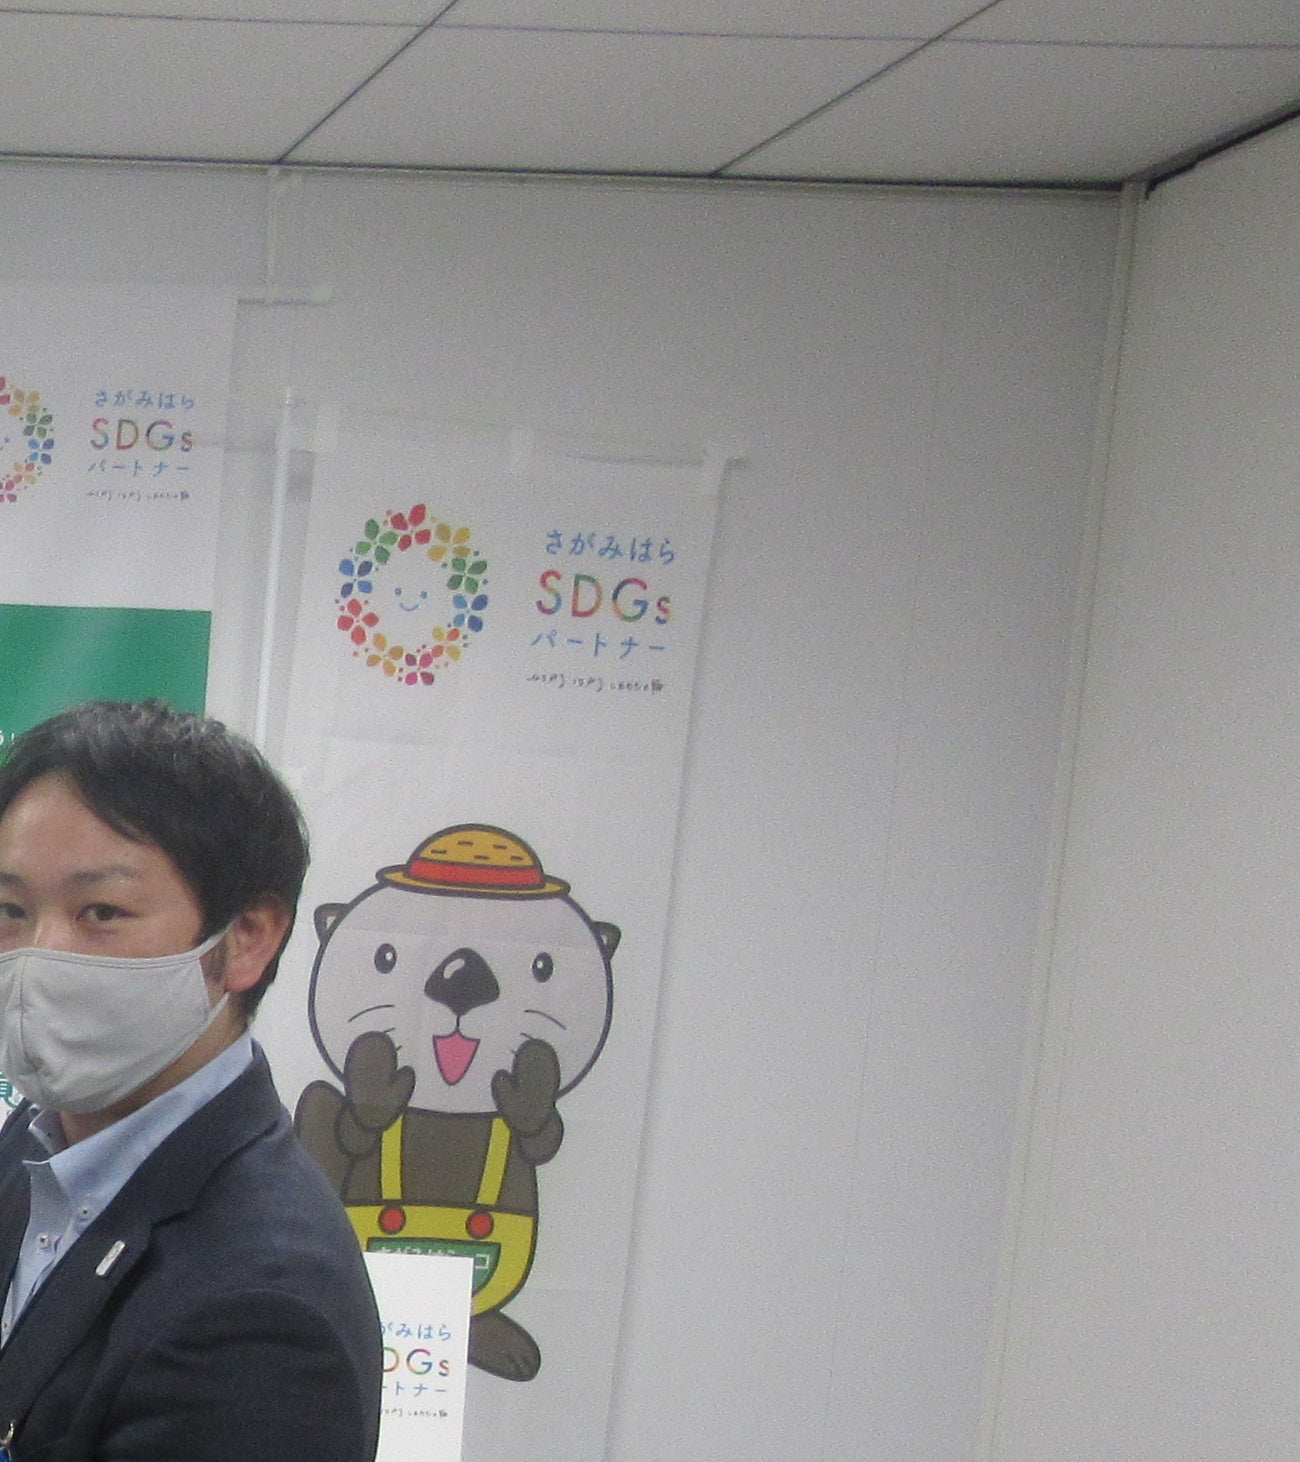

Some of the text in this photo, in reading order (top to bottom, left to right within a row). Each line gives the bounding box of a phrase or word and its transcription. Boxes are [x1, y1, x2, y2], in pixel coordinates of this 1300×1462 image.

[93, 387, 197, 412] さがみはら
[89, 415, 196, 454] SDGs
[86, 458, 192, 478] パートナー
[546, 529, 675, 565] さがみはら
[535, 569, 671, 624] SDGs
[531, 629, 665, 659] パートナー
